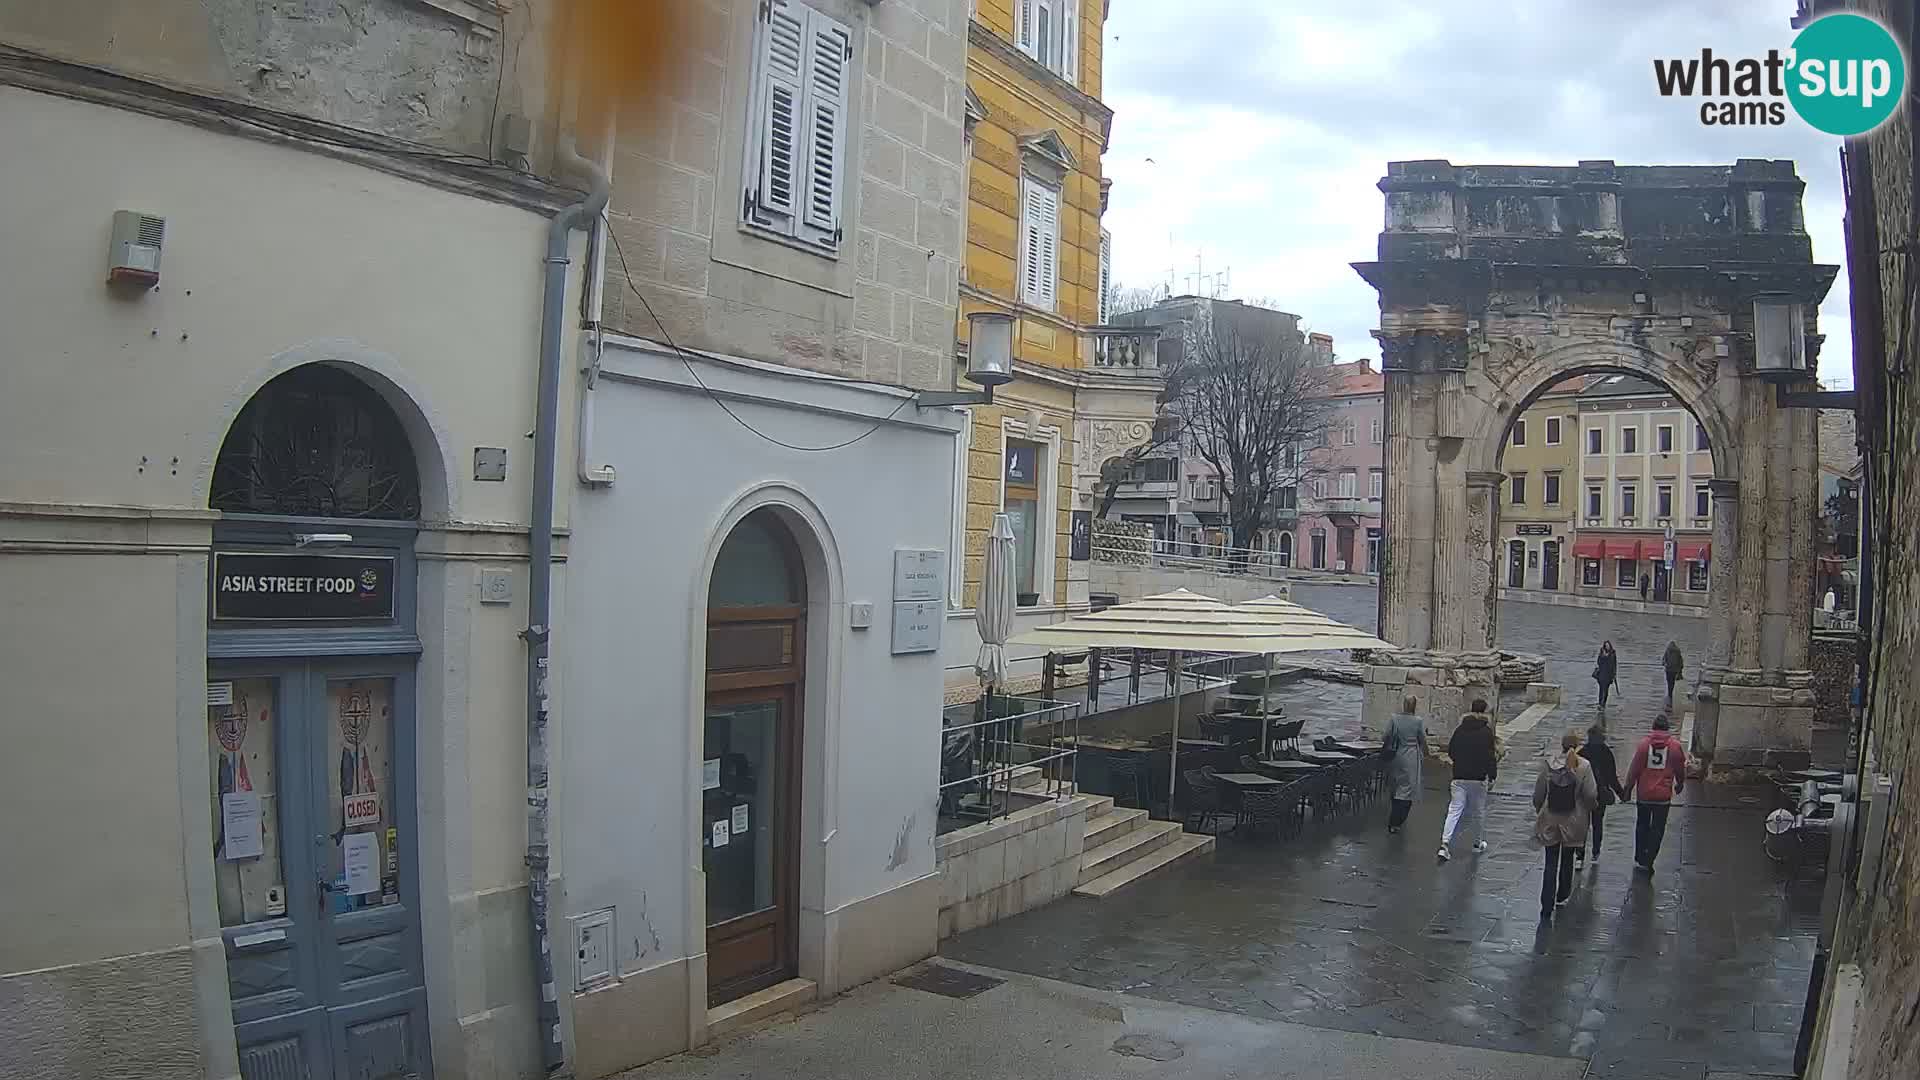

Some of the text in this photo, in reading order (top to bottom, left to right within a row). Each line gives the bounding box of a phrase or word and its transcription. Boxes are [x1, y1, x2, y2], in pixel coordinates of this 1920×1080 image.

[222, 576, 356, 593] ASIA STREET FOOD
[1652, 747, 1663, 765] 5
[347, 800, 376, 818] CLOSED
